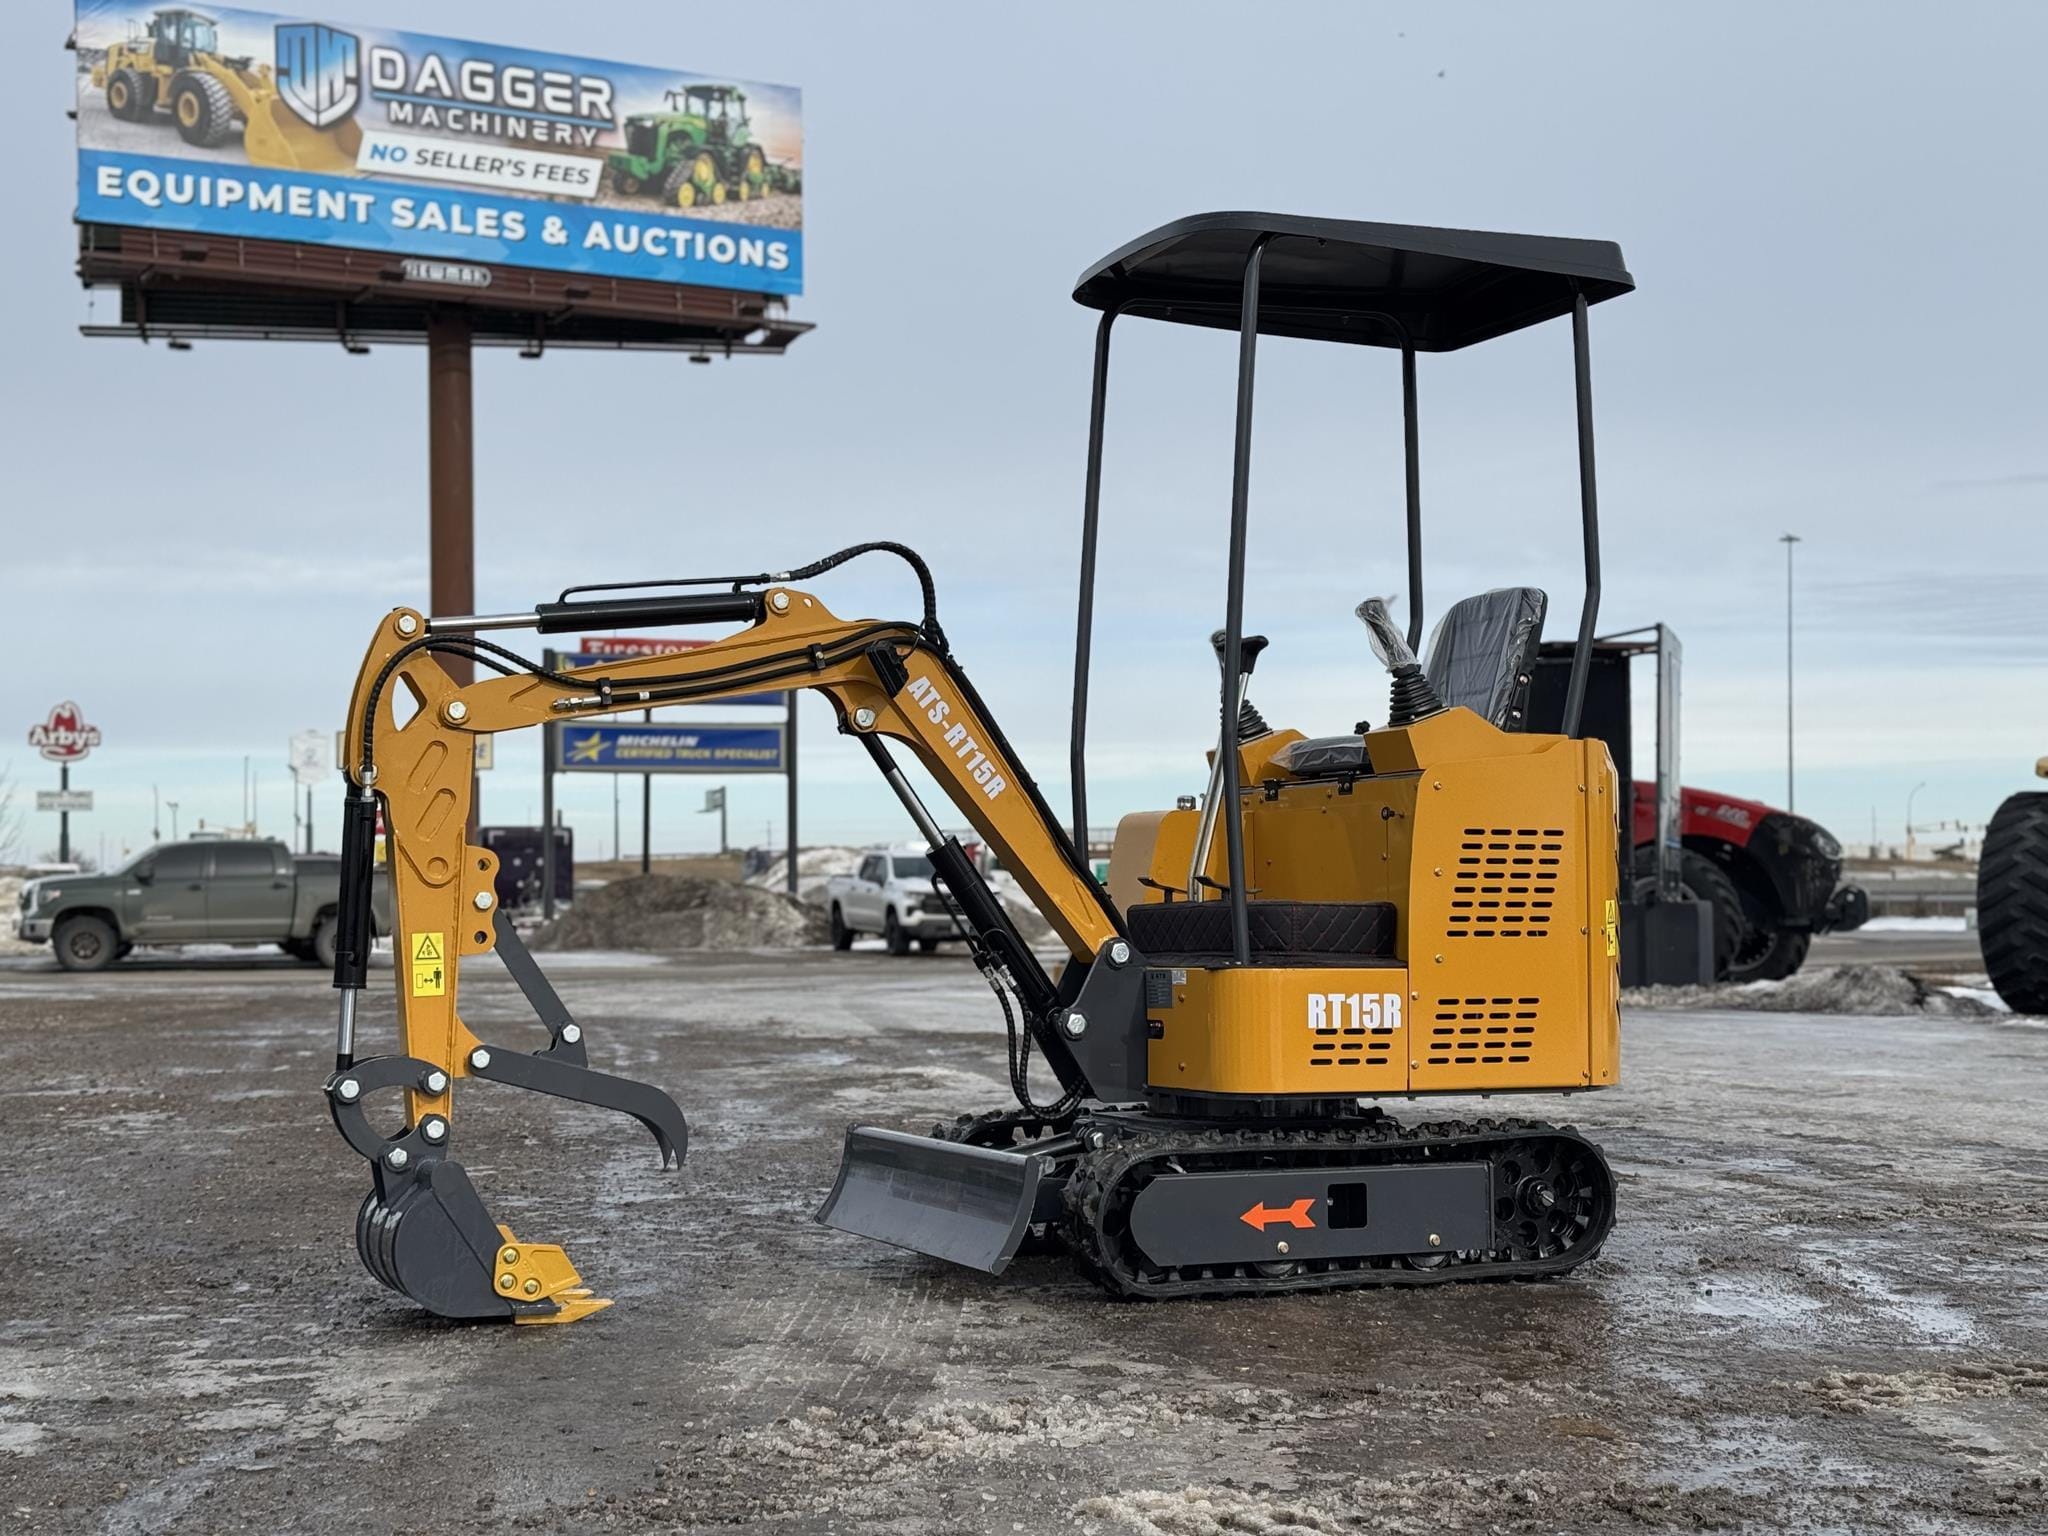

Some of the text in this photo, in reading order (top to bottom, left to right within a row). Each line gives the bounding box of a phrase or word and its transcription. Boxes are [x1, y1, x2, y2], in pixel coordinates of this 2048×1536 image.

[370, 47, 613, 119] DAGGER
[389, 101, 598, 147] MACHINERY
[370, 143, 591, 184] NO SELLER'S FEES
[97, 166, 789, 270] EQUIPMENT SALES & AUCTIONS
[31, 726, 99, 750] Arby's
[617, 735, 699, 747] MICHELIN
[907, 676, 1006, 800] ATS-RT15R
[1307, 993, 1402, 1029] RT15R
